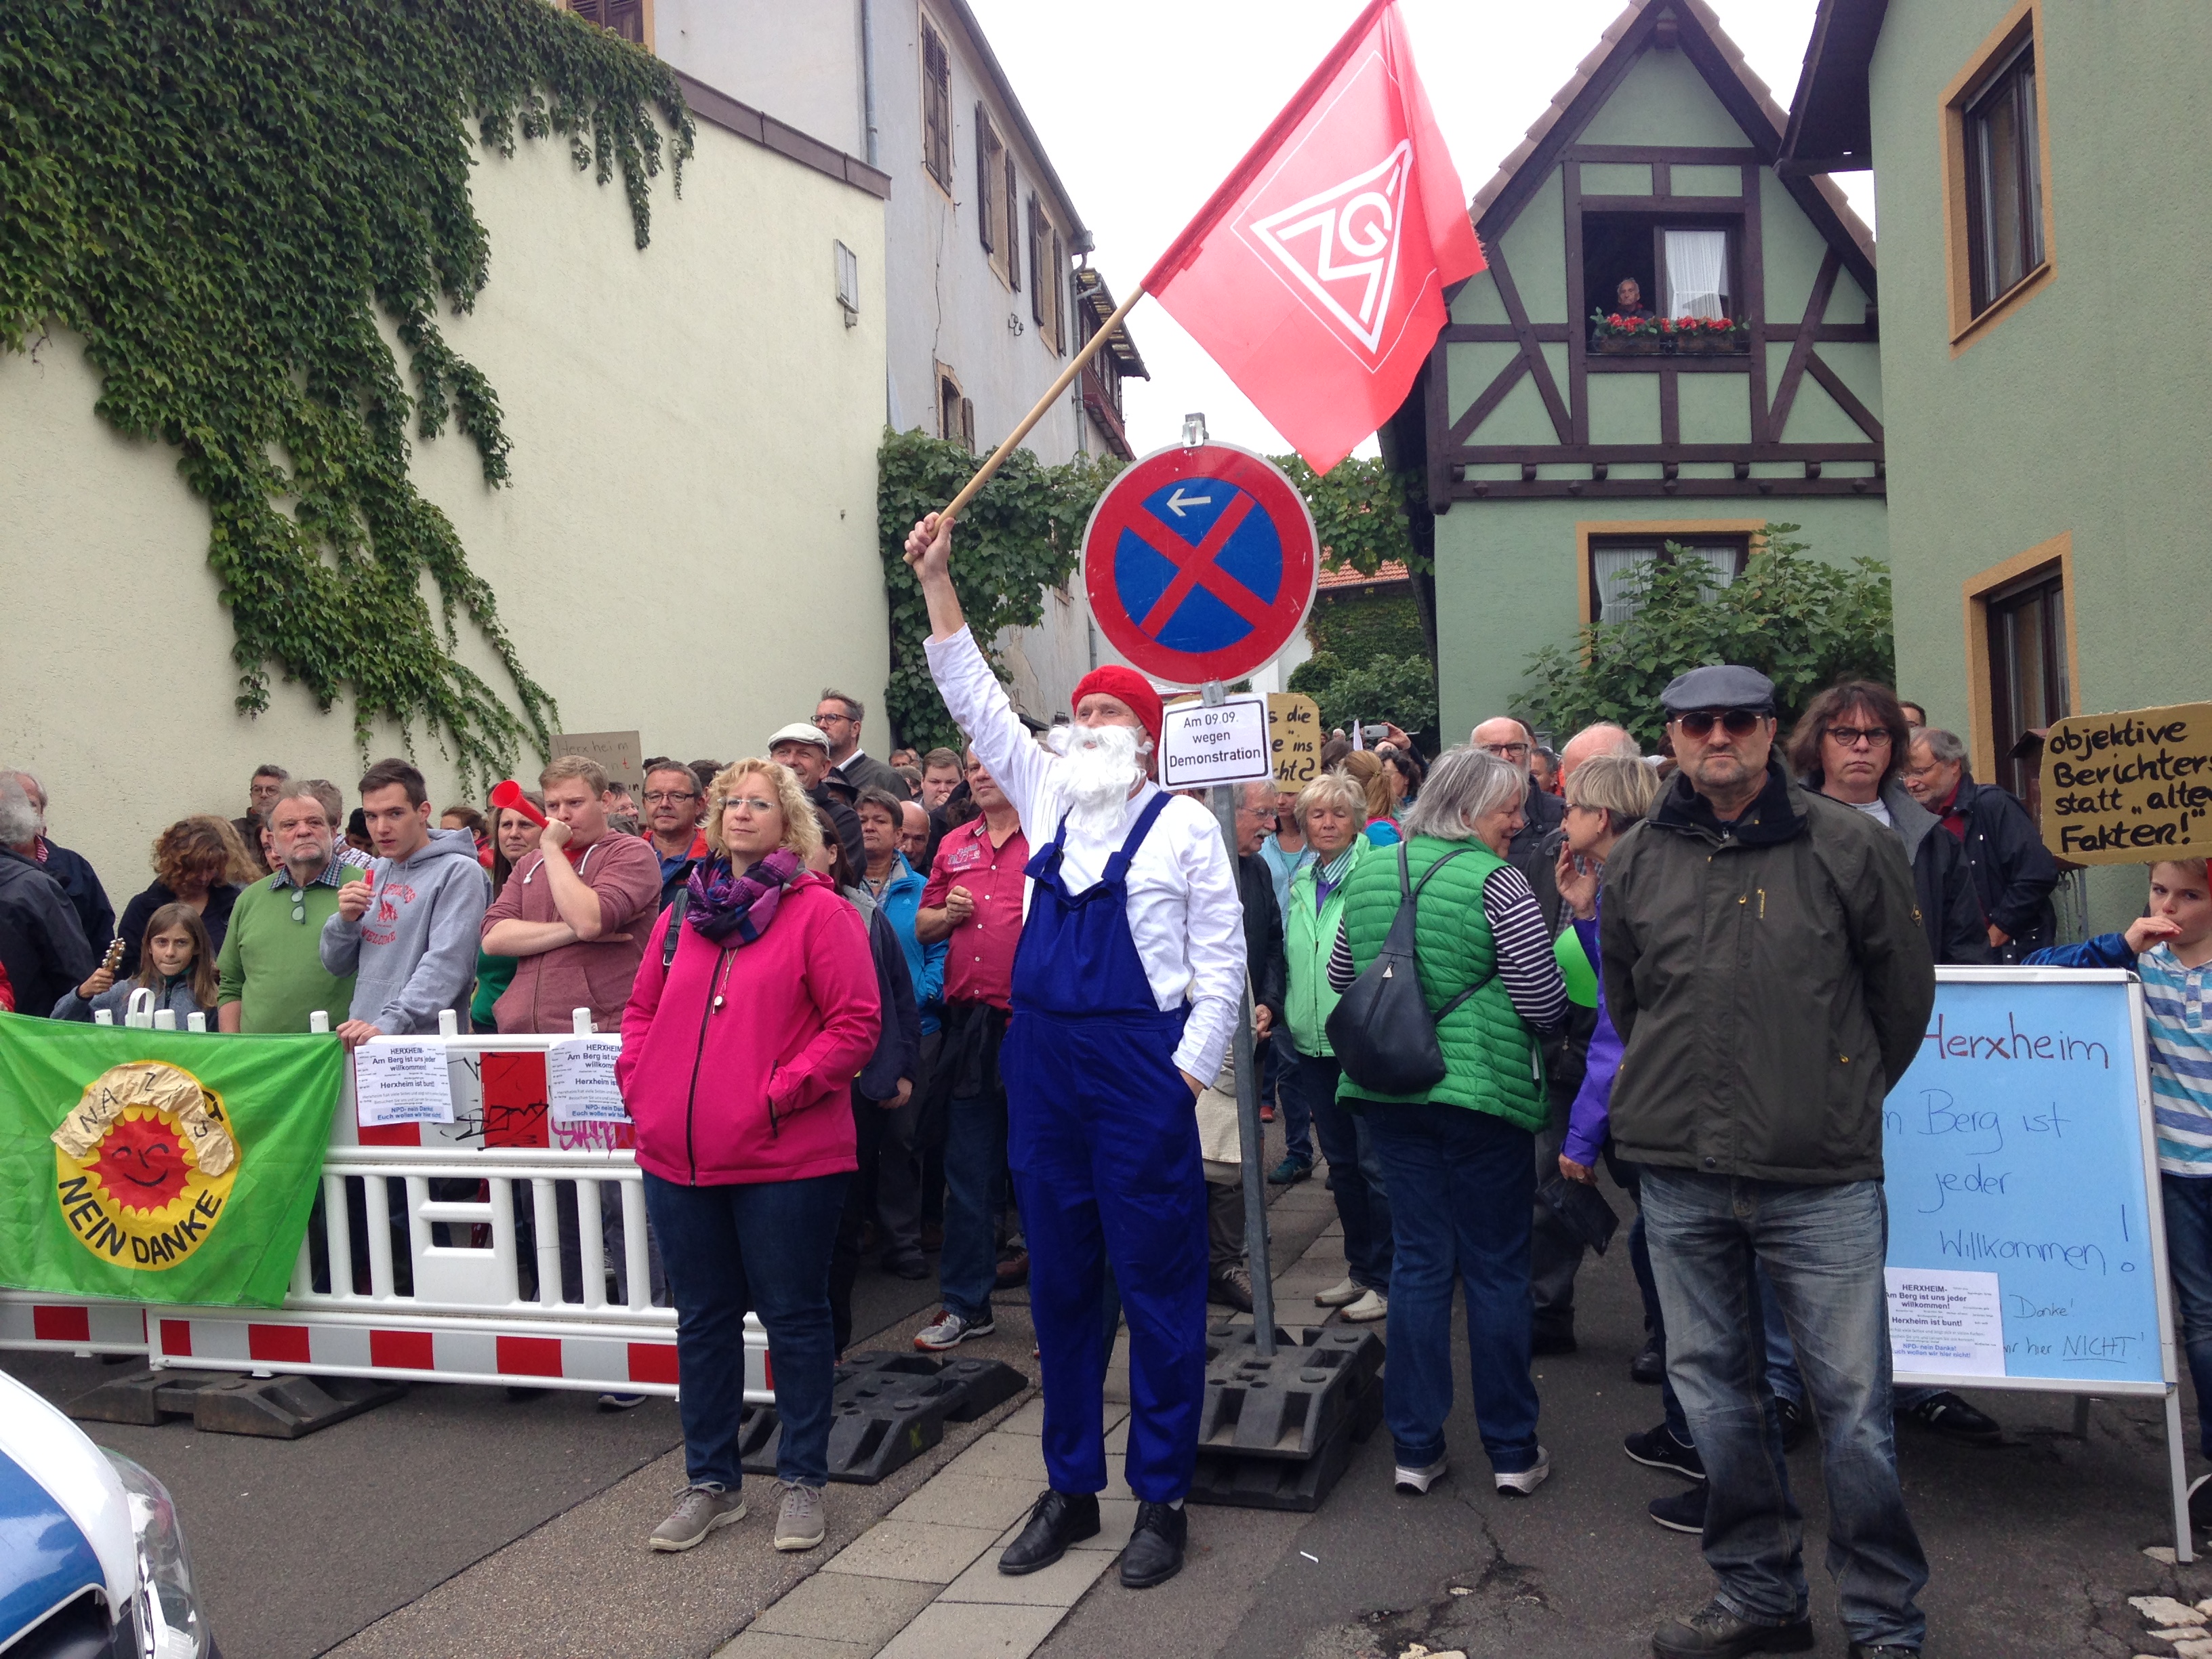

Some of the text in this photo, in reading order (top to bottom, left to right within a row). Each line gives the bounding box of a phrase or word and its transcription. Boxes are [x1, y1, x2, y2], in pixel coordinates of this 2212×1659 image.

[1184, 712, 1239, 728] Am 09.09.
[1287, 704, 1311, 724] die
[1193, 732, 1231, 744] wegen
[1293, 741, 1313, 752] ins
[2050, 718, 2188, 761] objektive
[1170, 747, 1261, 767] Demonstration
[2055, 787, 2123, 816] statt
[1924, 1012, 2109, 1069] Herxheim
[583, 1052, 600, 1061] Berg
[381, 1080, 414, 1088] Herxheim
[1918, 1089, 2003, 1155] Berg
[2023, 1102, 2071, 1138] ist
[1918, 1163, 2012, 1213] jeder
[58, 1176, 222, 1265] NEIN DANKE
[1899, 1292, 1917, 1301] Berg
[1947, 1294, 1967, 1303] jeder
[1902, 1301, 1950, 1309] willkommen!
[1892, 1317, 1928, 1325] Herxheim
[1942, 1319, 1962, 1327] bunt!
[2026, 1336, 2053, 1355] hier
